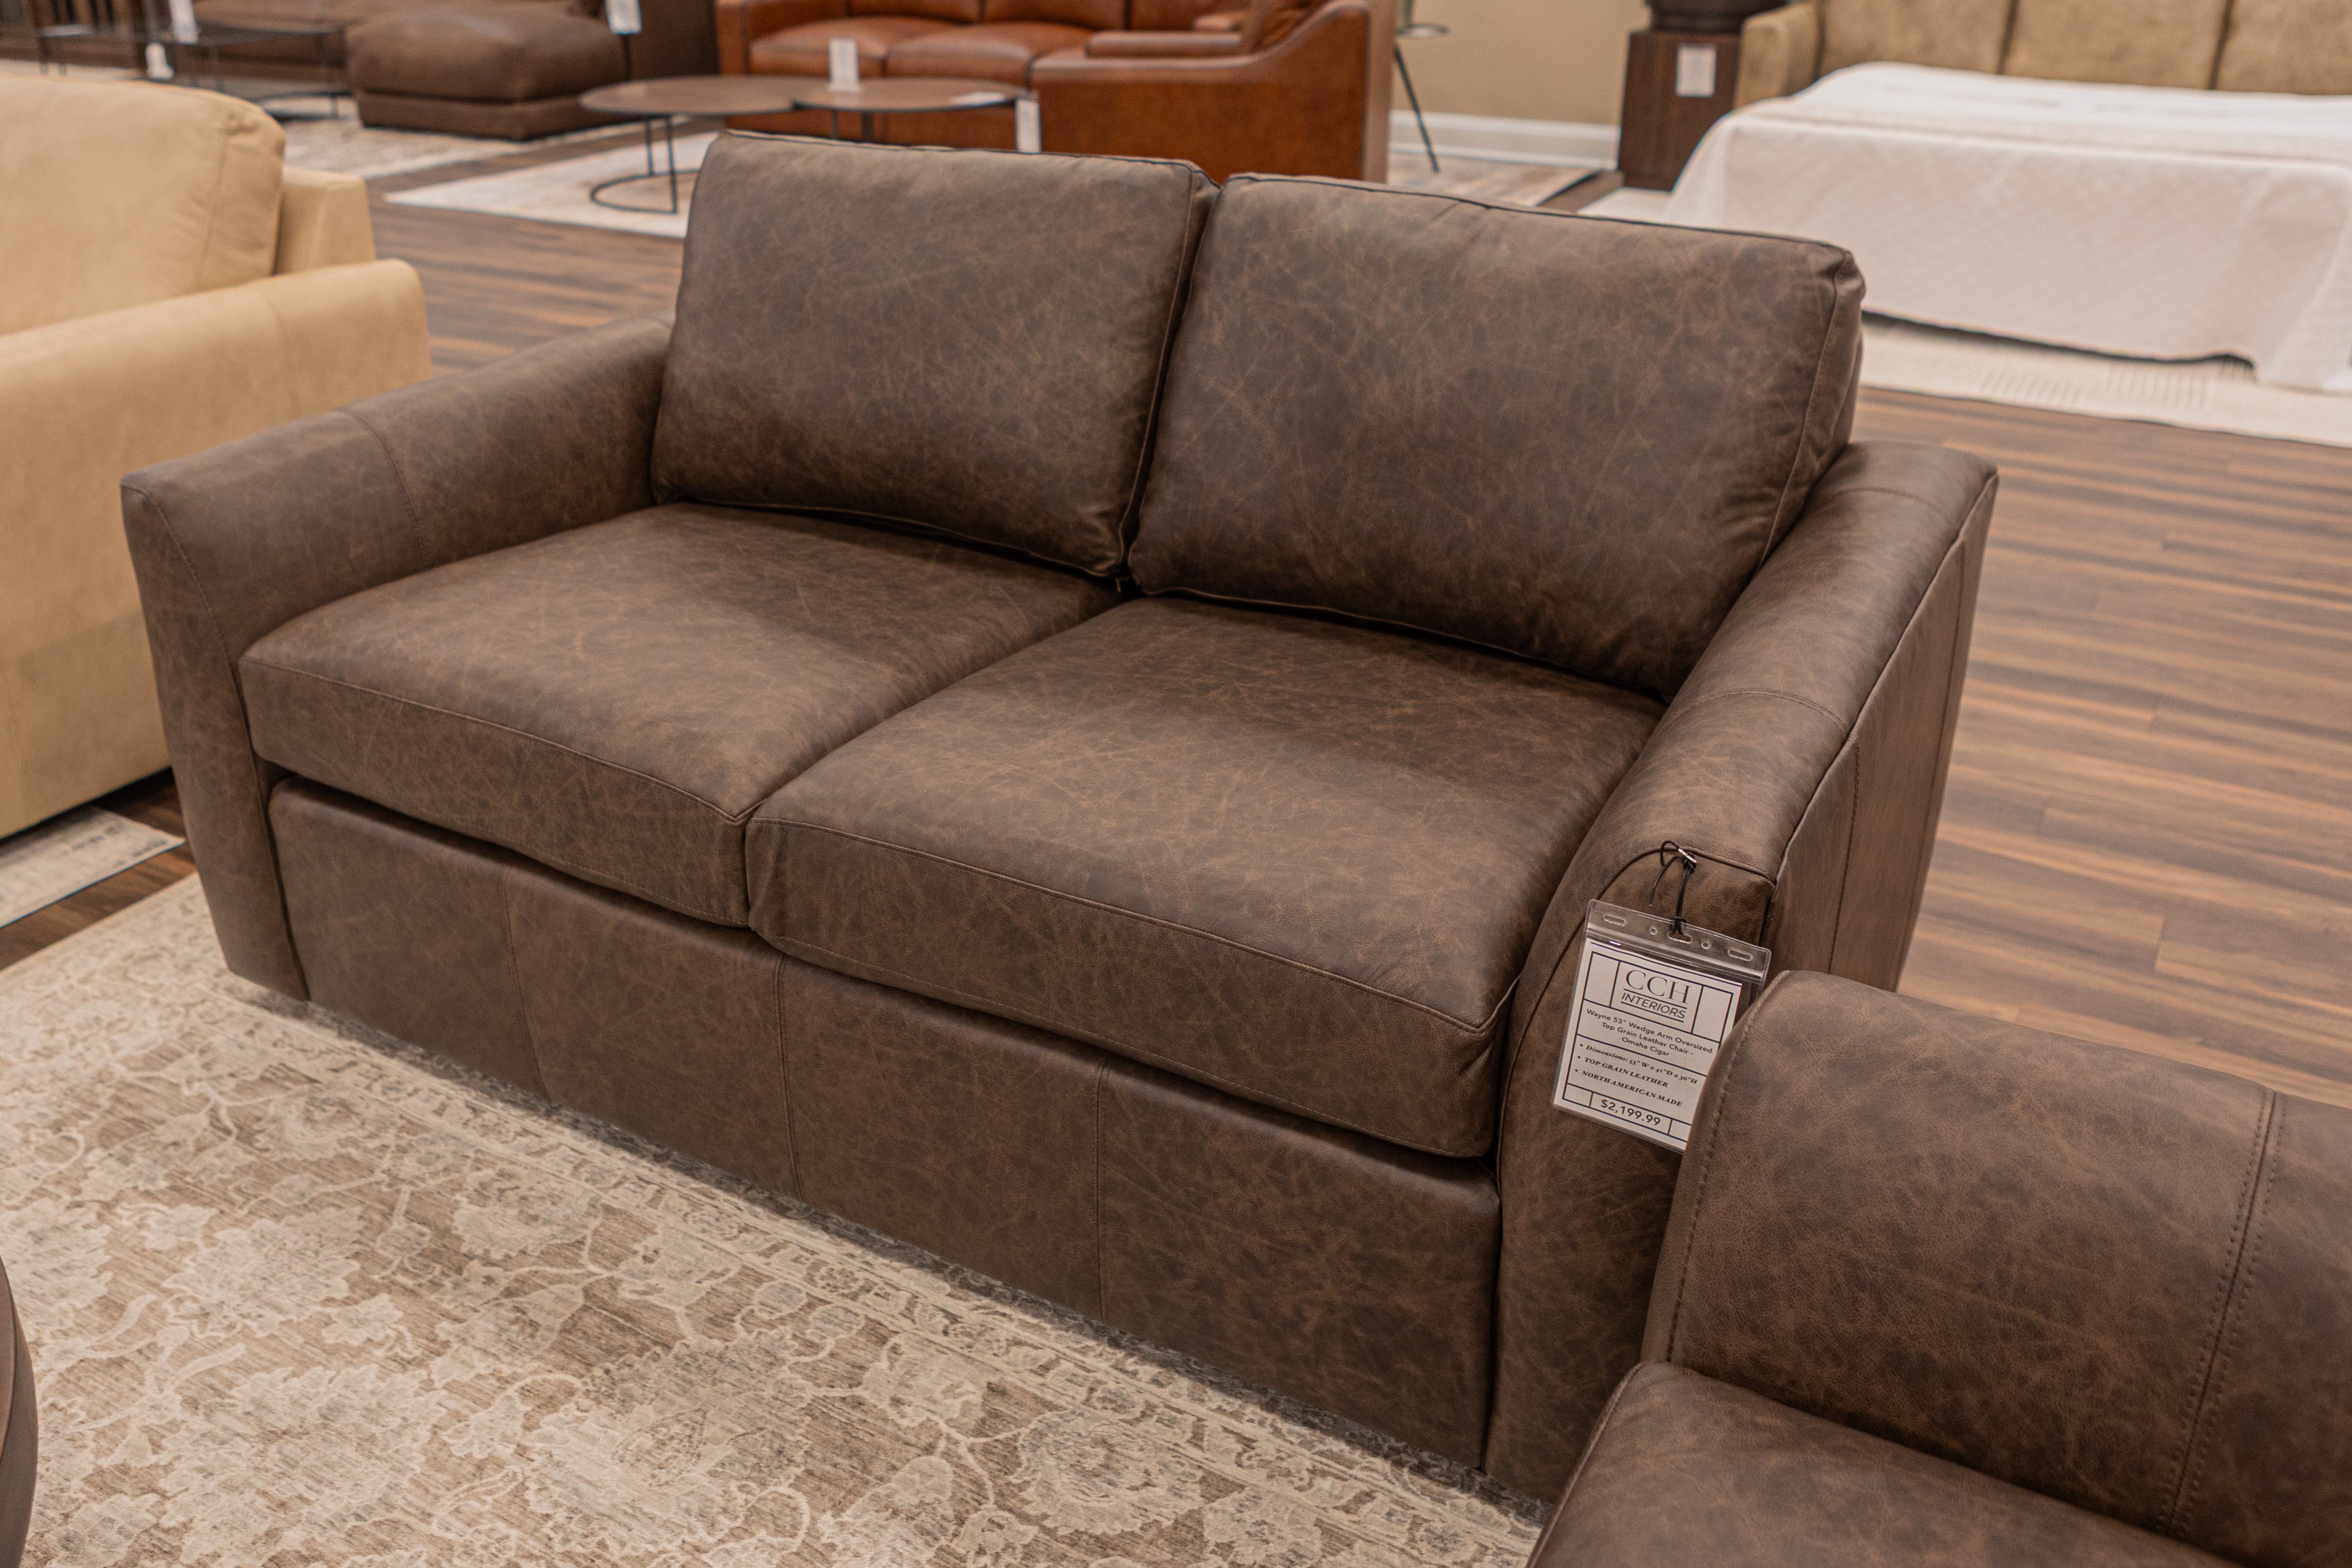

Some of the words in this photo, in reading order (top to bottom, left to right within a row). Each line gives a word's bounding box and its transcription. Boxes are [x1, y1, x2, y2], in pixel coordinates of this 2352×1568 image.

[1626, 970, 1692, 1004] CCH
[1622, 992, 1686, 1018] INTERIORS
[1587, 1009, 1611, 1021] Wayne
[1629, 1022, 1655, 1034] Wedge
[1657, 1032, 1673, 1041] Arm
[1675, 1037, 1712, 1053] Oversized
[1602, 1022, 1615, 1031] Top
[1617, 1027, 1637, 1037] Grain
[1639, 1034, 1667, 1047] Leather
[1669, 1044, 1688, 1054] Chair
[1586, 1045, 1628, 1062] Dimensions:
[1622, 1037, 1647, 1049] Omaha
[1650, 1046, 1669, 1056] Cigar
[1602, 1063, 1629, 1075] GRAIN
[1630, 1072, 1668, 1087] LEATHER
[1582, 1071, 1611, 1083] NORTH
[1611, 1081, 1656, 1098] AMERICAN
[1657, 1095, 1682, 1107] MADE
[1601, 1099, 1660, 1125] $2,199.99
